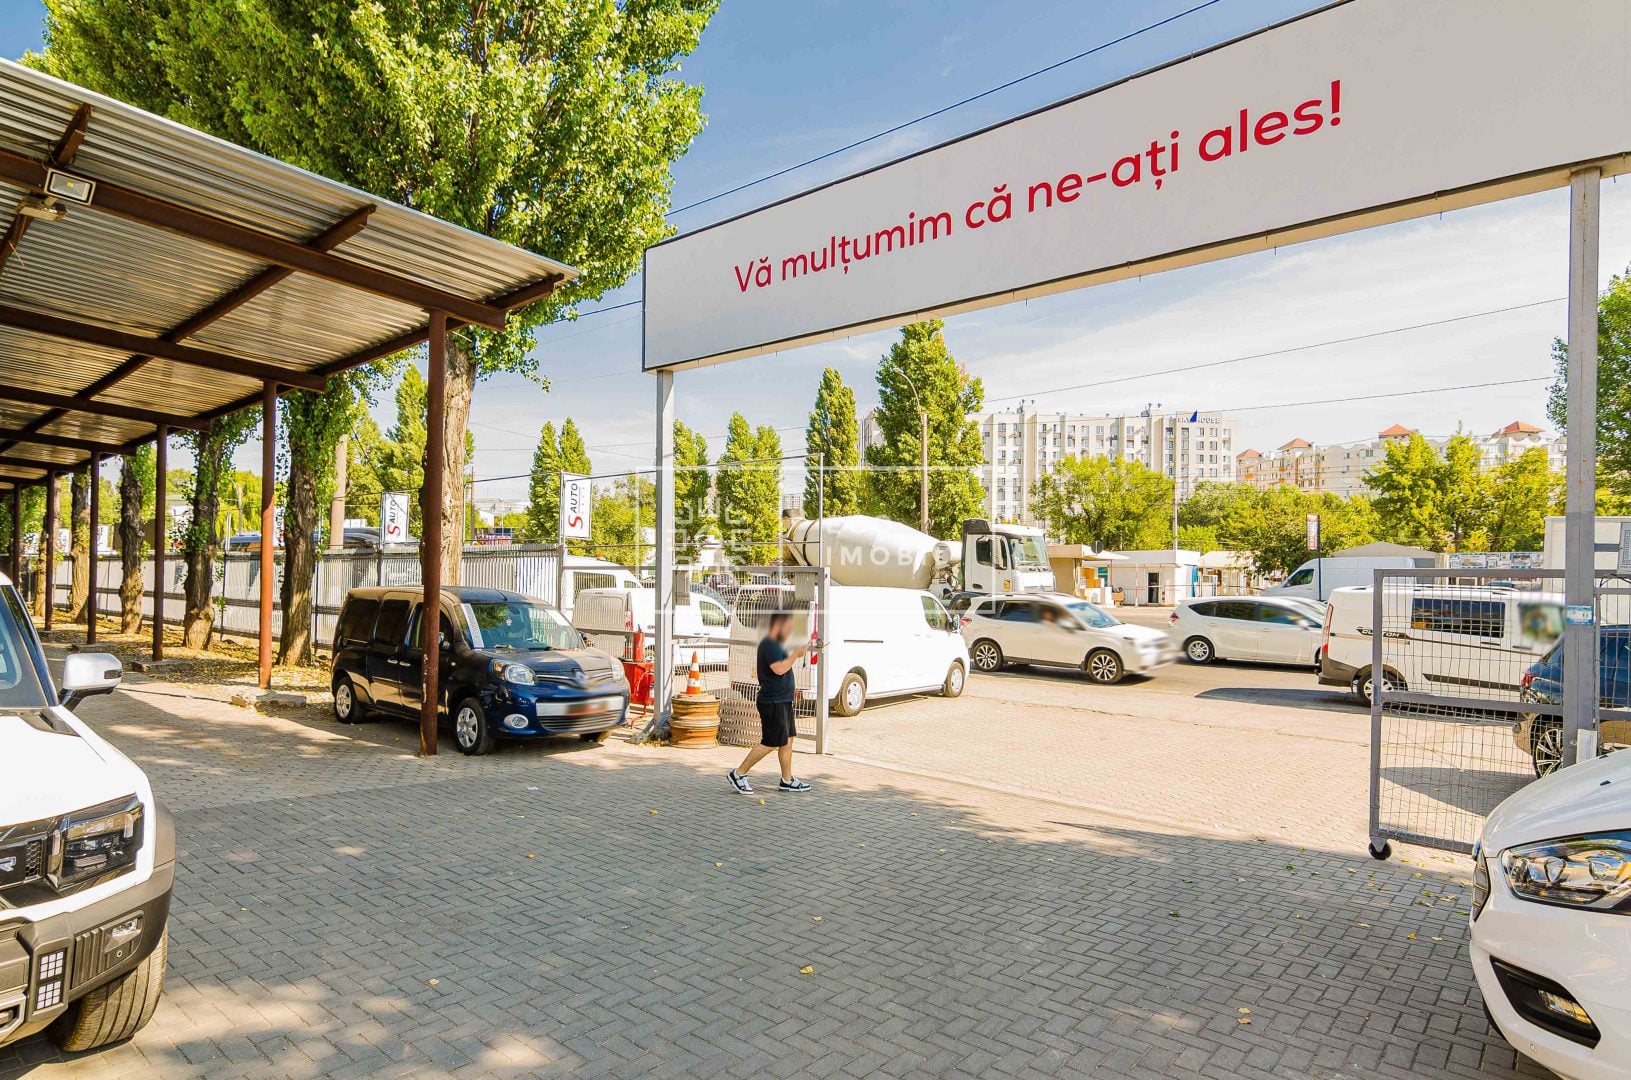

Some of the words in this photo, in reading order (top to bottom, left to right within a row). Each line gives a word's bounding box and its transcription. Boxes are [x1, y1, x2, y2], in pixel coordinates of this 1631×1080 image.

[736, 256, 772, 292] Vă
[781, 211, 952, 281] mulțumim
[965, 184, 1012, 229] că
[1028, 130, 1180, 213] ne-ați
[1198, 79, 1342, 163] ales!
[1361, 628, 1400, 638] CUTOM
